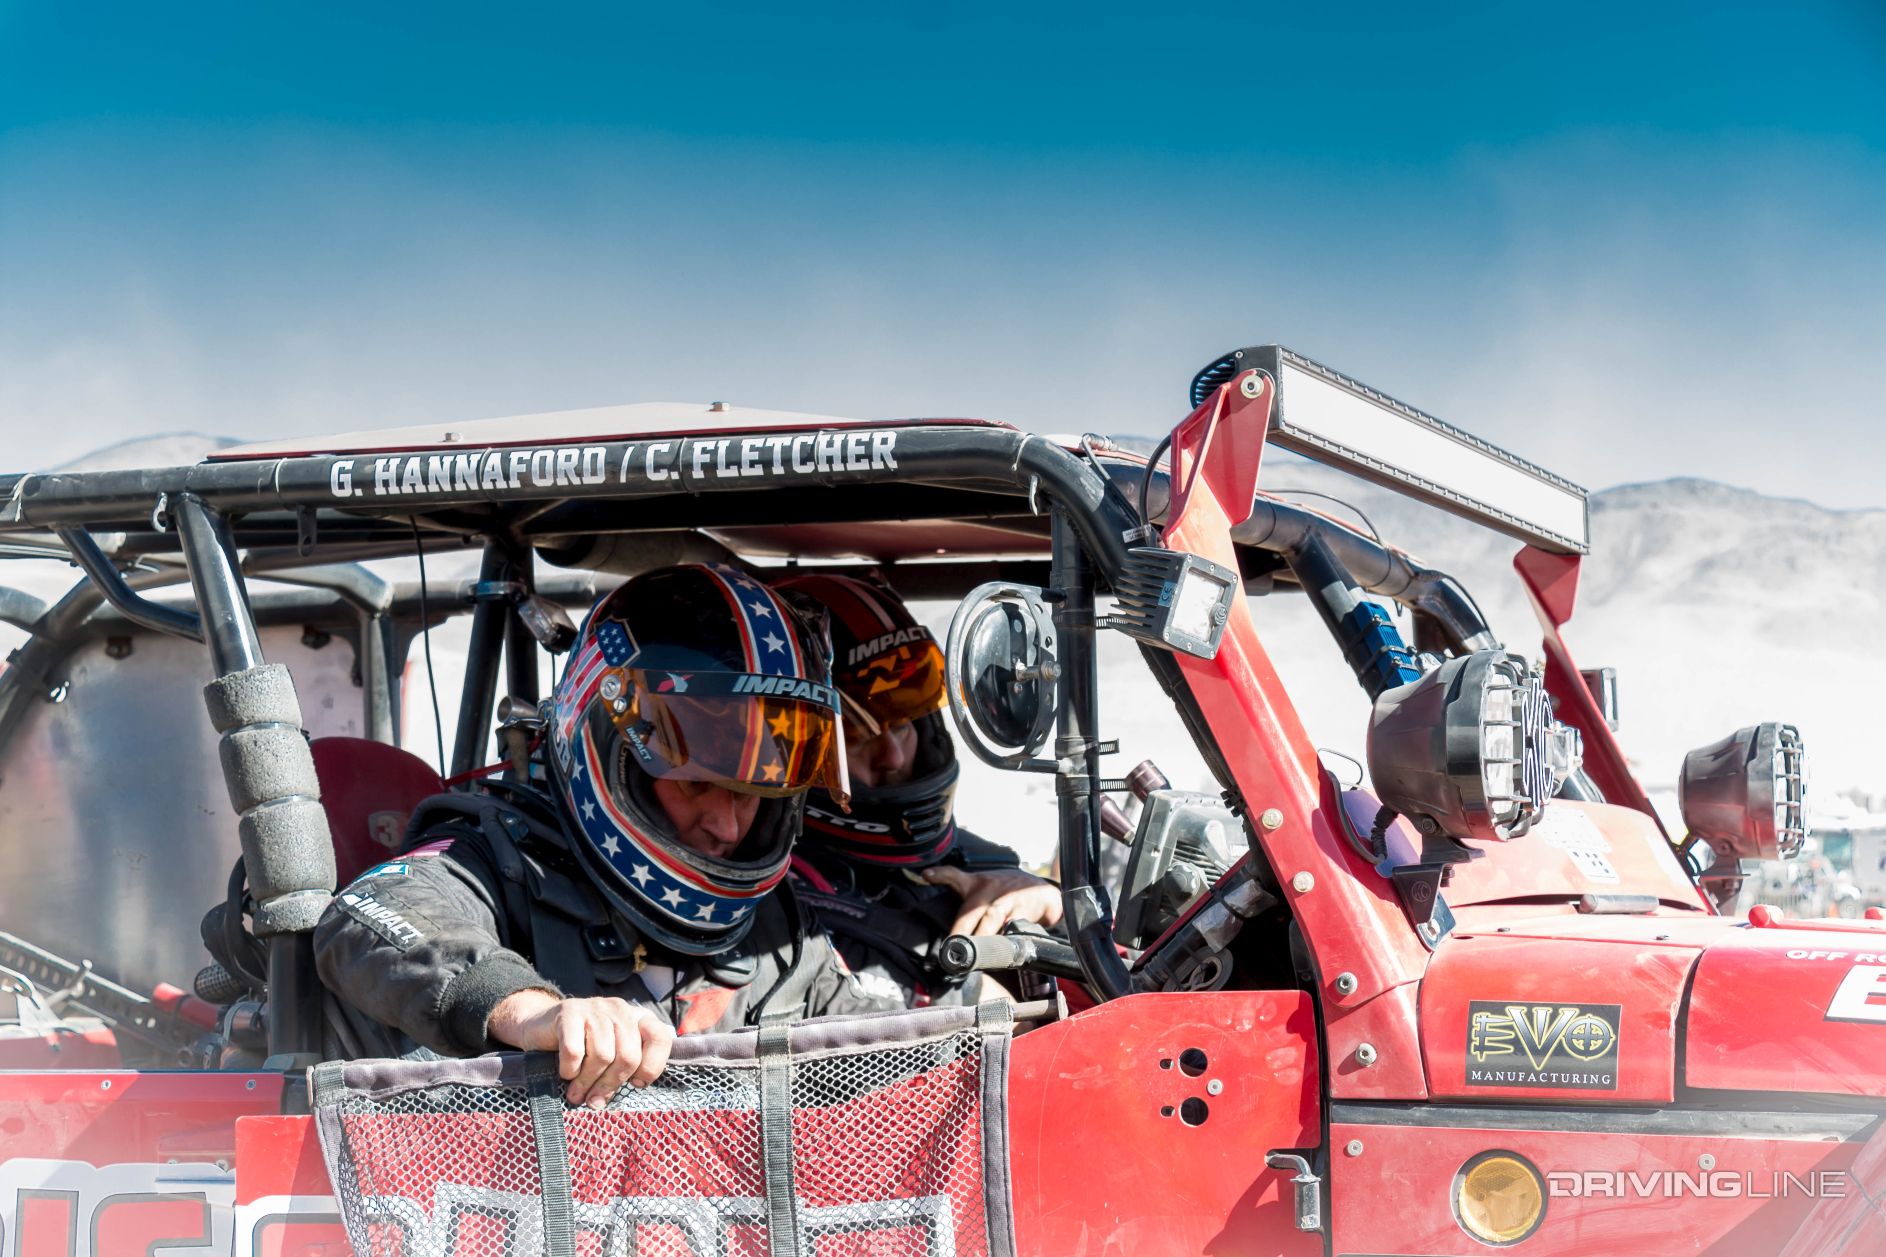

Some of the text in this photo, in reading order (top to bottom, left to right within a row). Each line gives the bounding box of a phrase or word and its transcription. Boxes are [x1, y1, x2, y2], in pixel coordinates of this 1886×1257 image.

[330, 460, 363, 498] G.
[374, 446, 606, 496] HANNAFORD
[646, 441, 680, 481] C.
[690, 431, 898, 479] FLETCHER
[849, 625, 929, 666] IMPACT
[732, 674, 838, 706] IMPACT
[626, 726, 652, 761] IMPACT
[354, 896, 425, 944] IMPACT
[1785, 949, 1849, 961] OFF
[1471, 1006, 1616, 1071] EVO
[1472, 1070, 1611, 1085] MANUFACTURING
